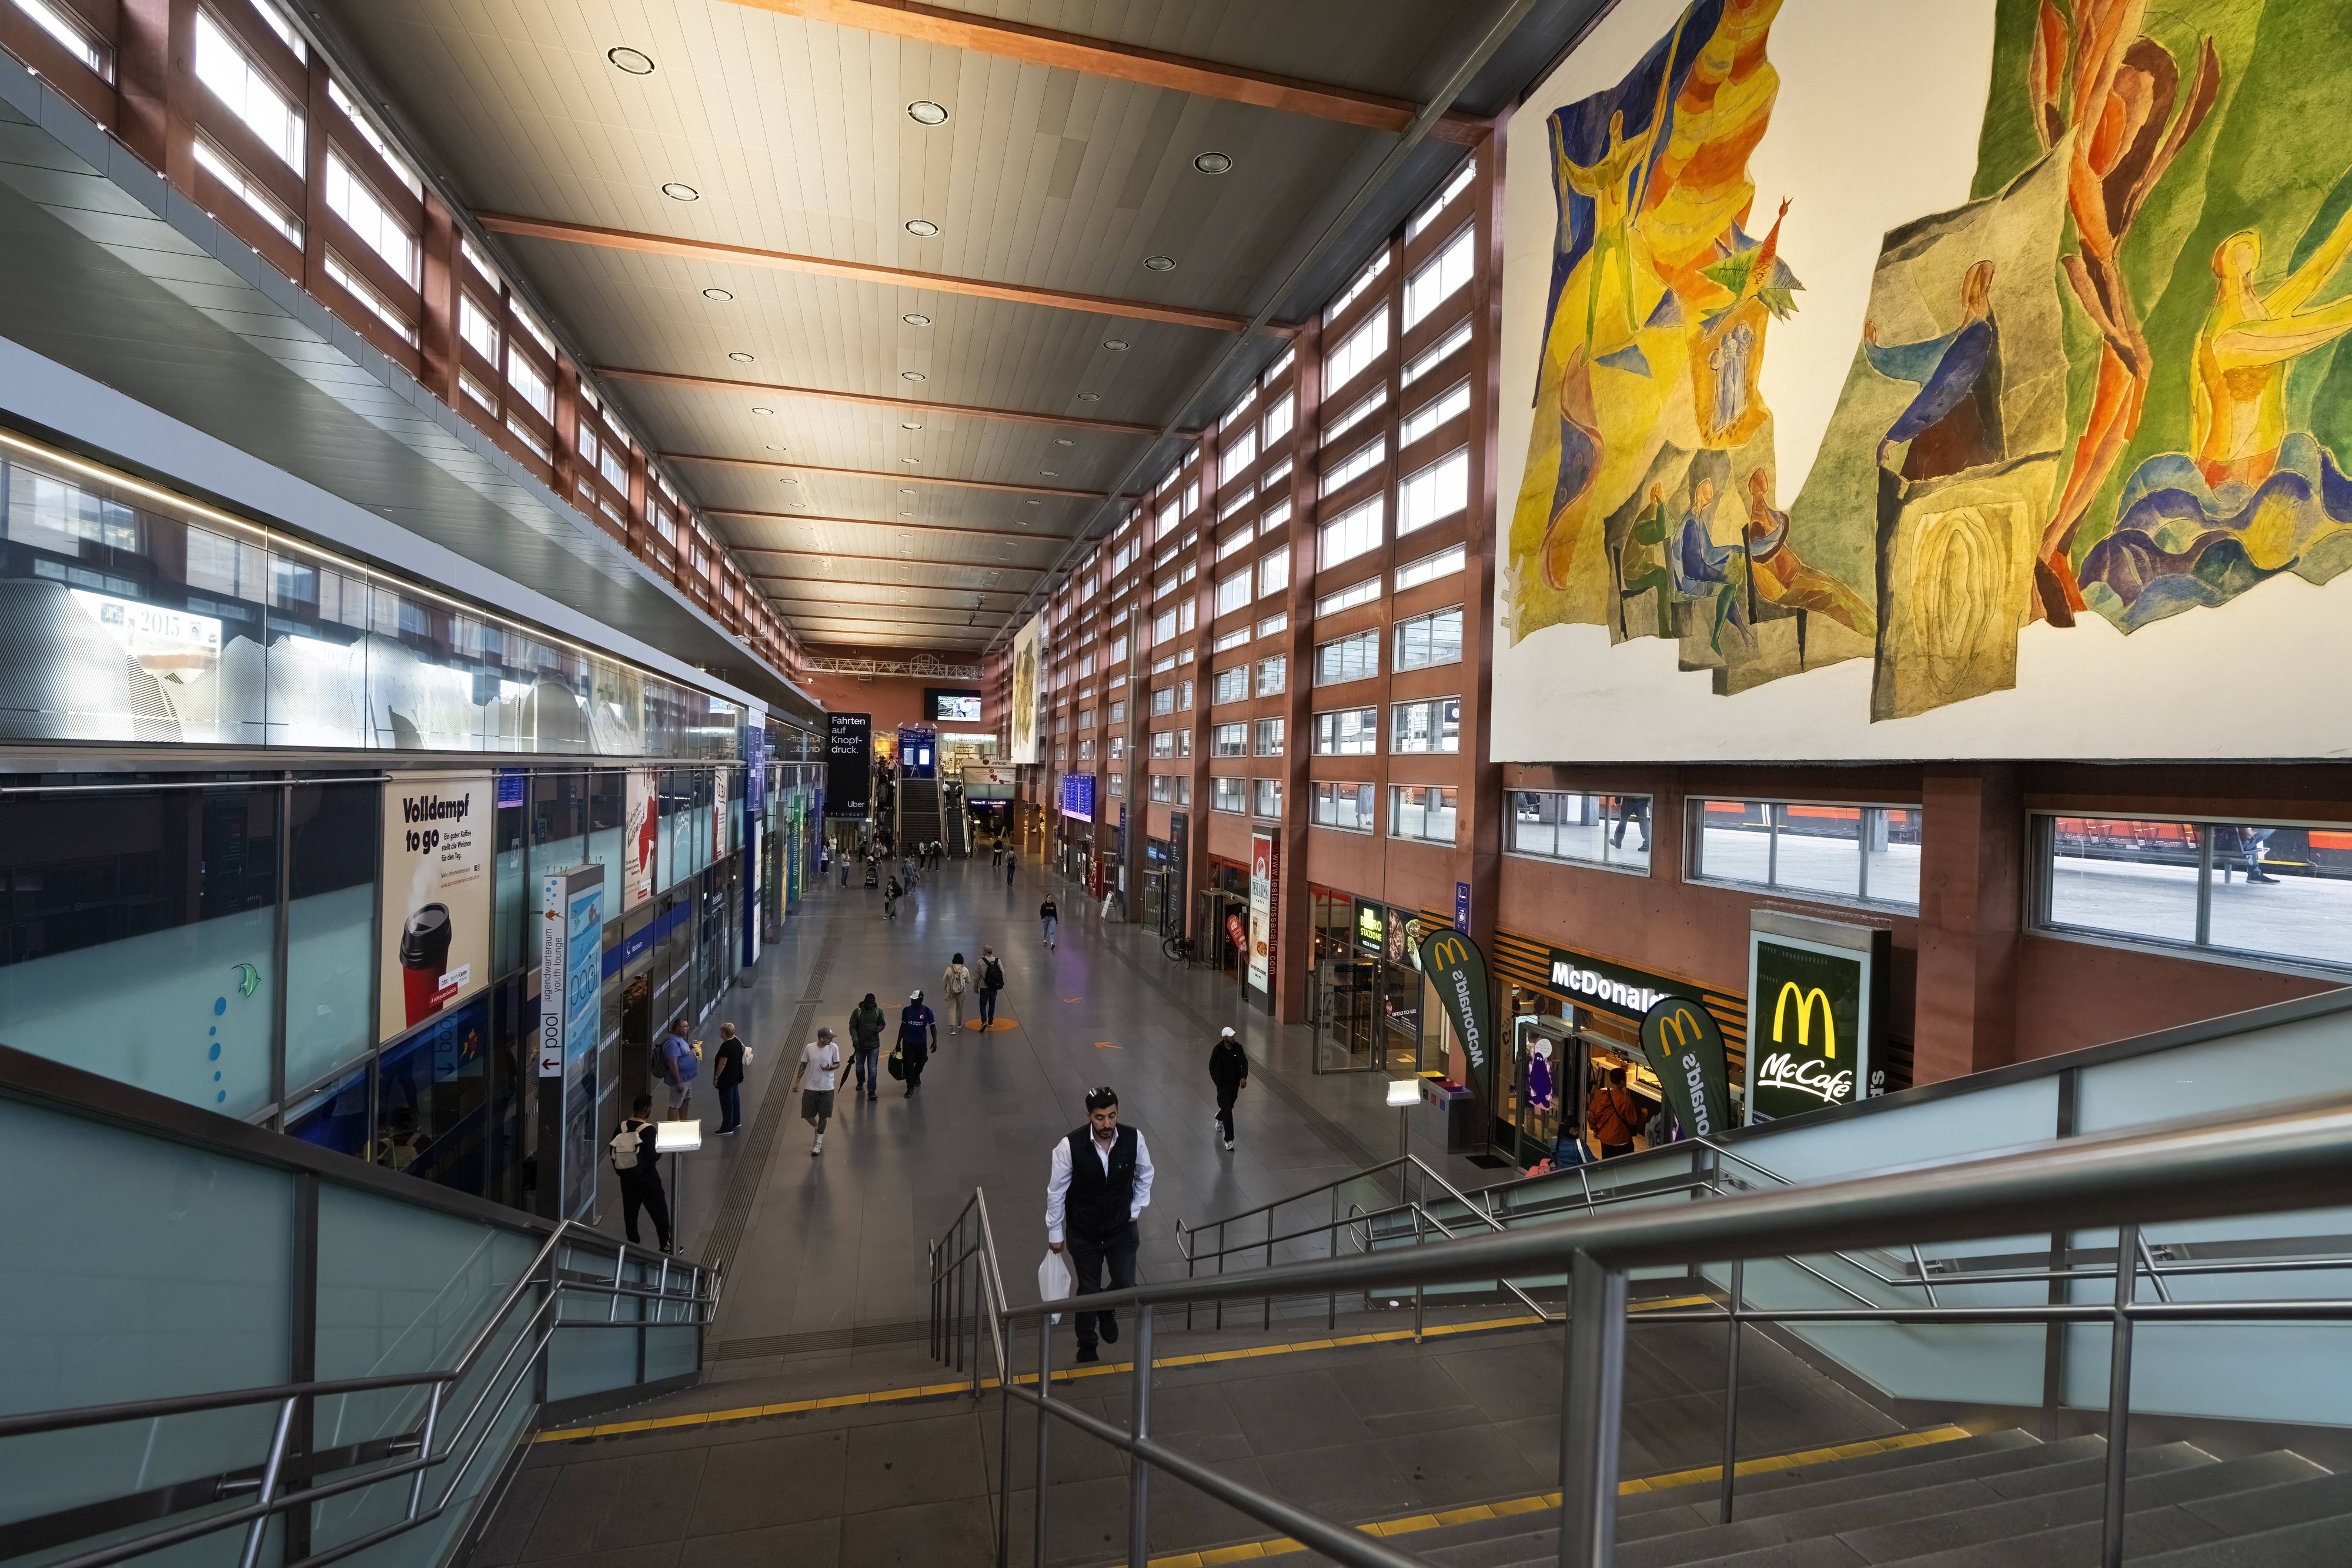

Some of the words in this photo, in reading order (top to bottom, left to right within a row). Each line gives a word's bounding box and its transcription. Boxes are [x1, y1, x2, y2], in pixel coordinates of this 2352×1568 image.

[140, 610, 180, 637] 2015
[832, 716, 866, 725] Fahrten
[831, 735, 863, 745] Knopf-
[831, 745, 858, 754] druck.
[403, 793, 469, 823] Volldampf
[406, 830, 420, 852] to
[423, 829, 439, 855] go
[442, 843, 450, 851] stellt
[450, 832, 460, 841] guter
[1269, 854, 1279, 974] www.testarossacaffe.com
[1360, 915, 1382, 932] BRO
[1360, 928, 1382, 942] STAZIONE
[554, 937, 563, 965] lounge
[543, 928, 552, 1002] jugendwarteraum
[554, 969, 562, 992] youth
[1552, 962, 1671, 1013] McDonal
[542, 1013, 562, 1049] pool
[1760, 1053, 1852, 1102] McCafé
